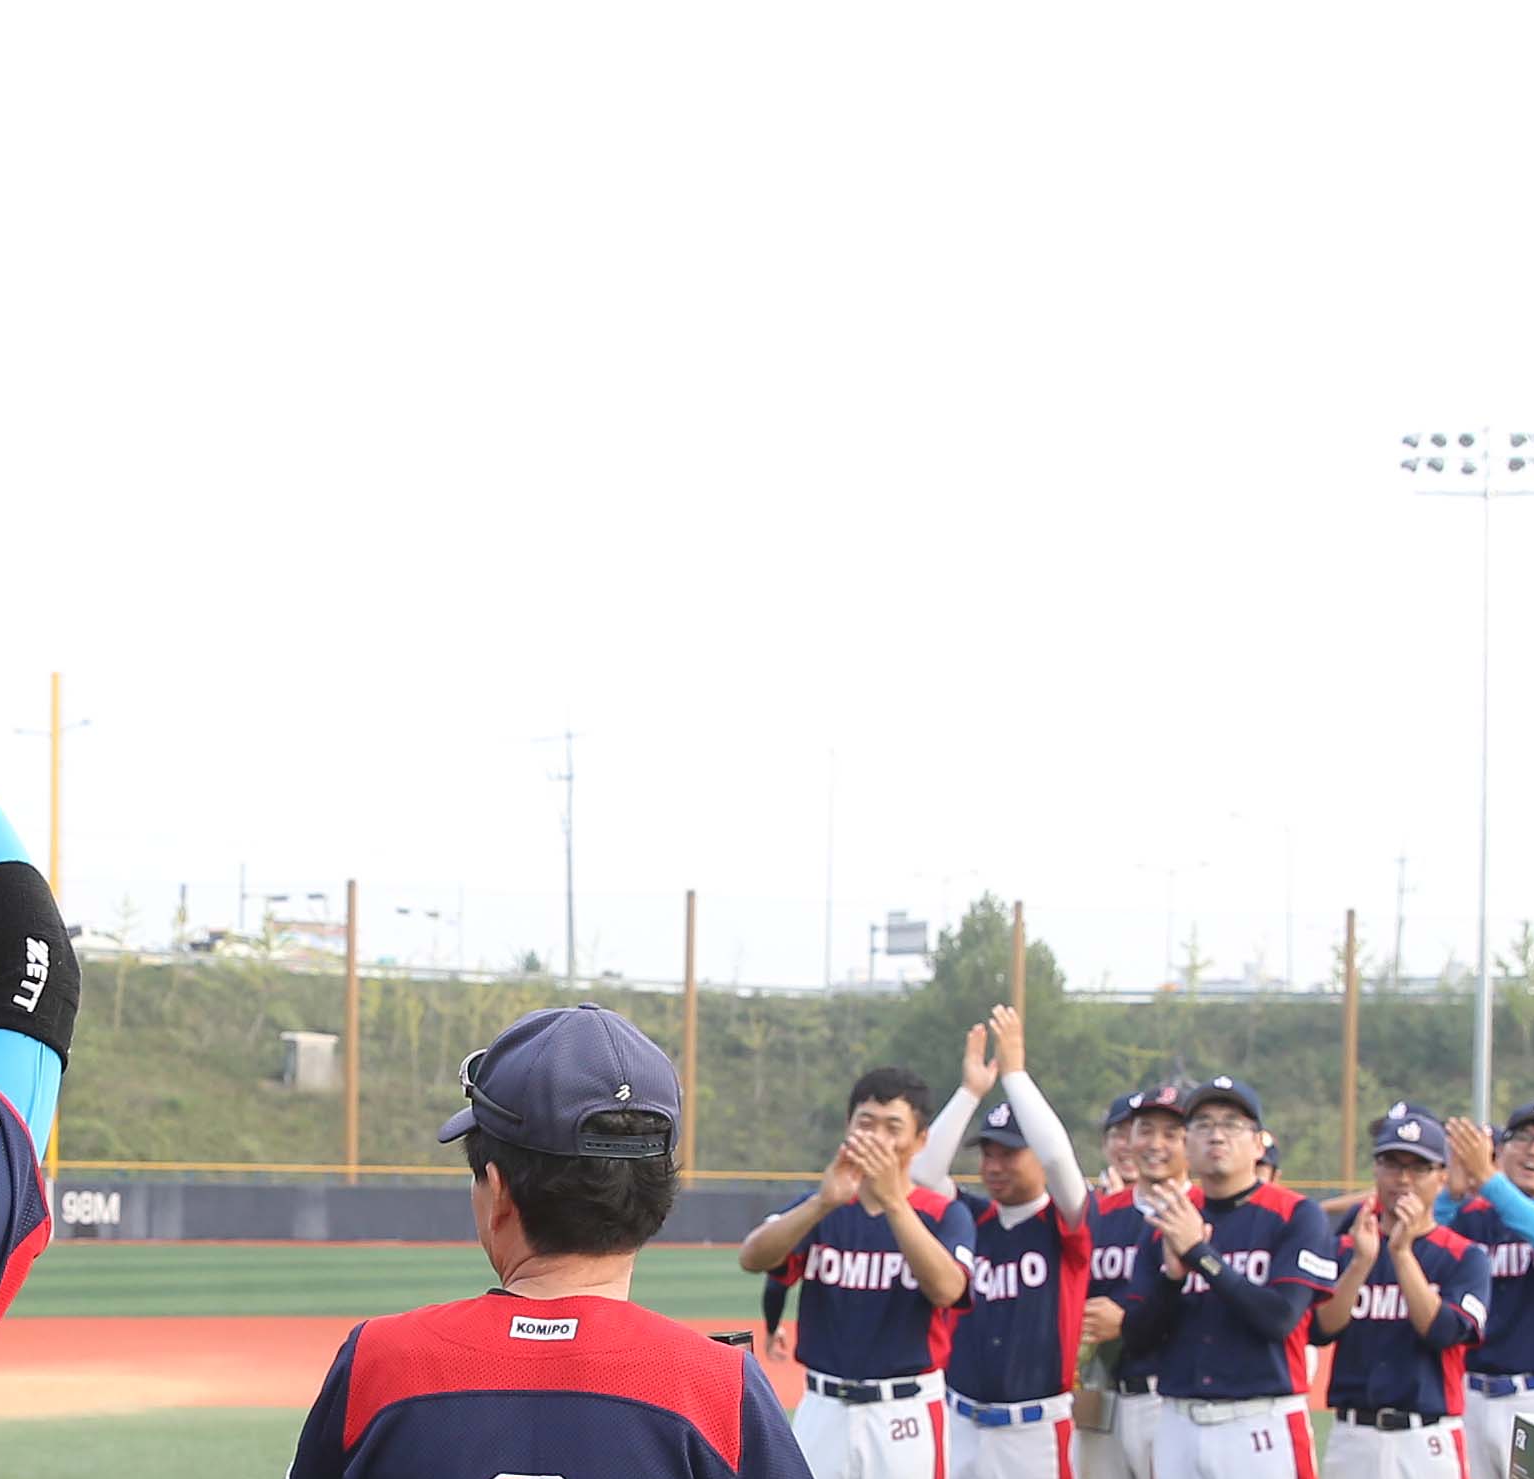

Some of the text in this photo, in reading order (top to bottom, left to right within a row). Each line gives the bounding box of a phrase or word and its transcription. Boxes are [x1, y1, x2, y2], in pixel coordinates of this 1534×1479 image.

[12, 937, 52, 1013] ZETT
[62, 1190, 121, 1225] 98M
[516, 1321, 571, 1338] KOMIPO
[890, 1416, 920, 1441] 20
[1250, 1430, 1274, 1452] 11
